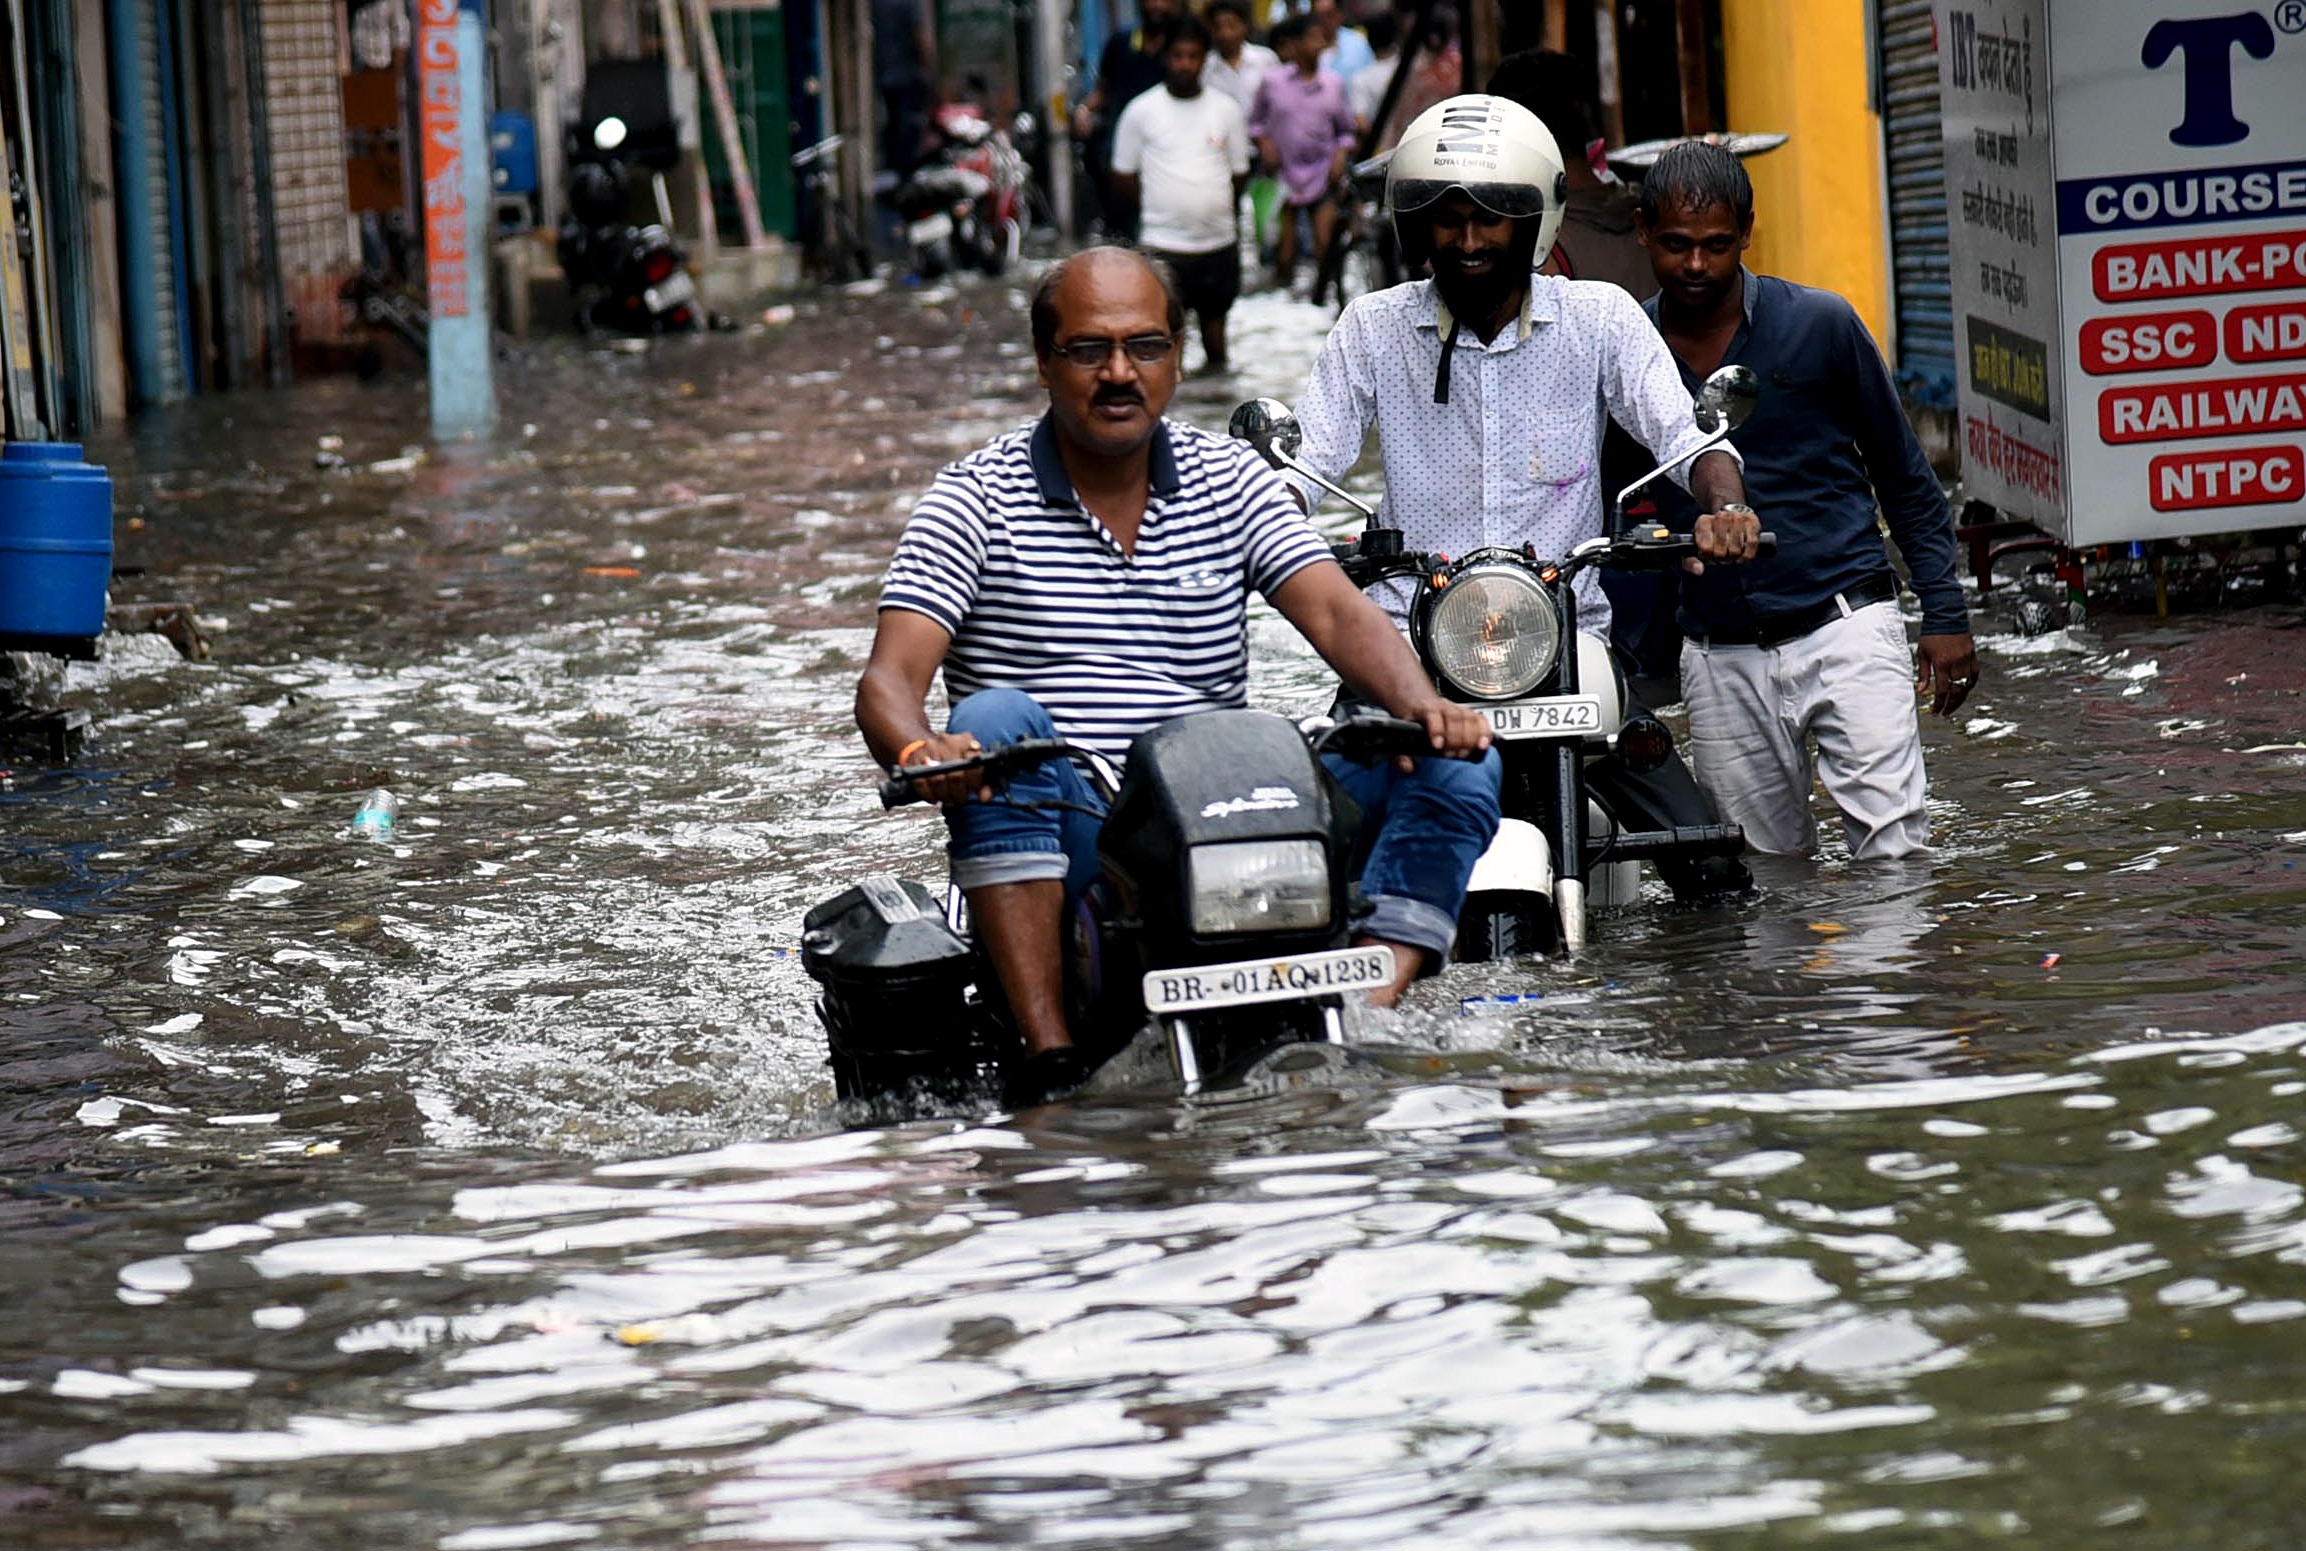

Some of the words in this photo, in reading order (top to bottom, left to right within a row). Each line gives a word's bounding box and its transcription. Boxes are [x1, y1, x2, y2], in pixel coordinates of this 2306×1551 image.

[2085, 169, 2306, 224] COURSE
[2101, 322, 2196, 364] SSC
[2113, 384, 2306, 434] RAILWA
[2160, 457, 2292, 501] NTPC
[1532, 706, 1590, 728] 7842
[1325, 956, 1384, 986] 1238
